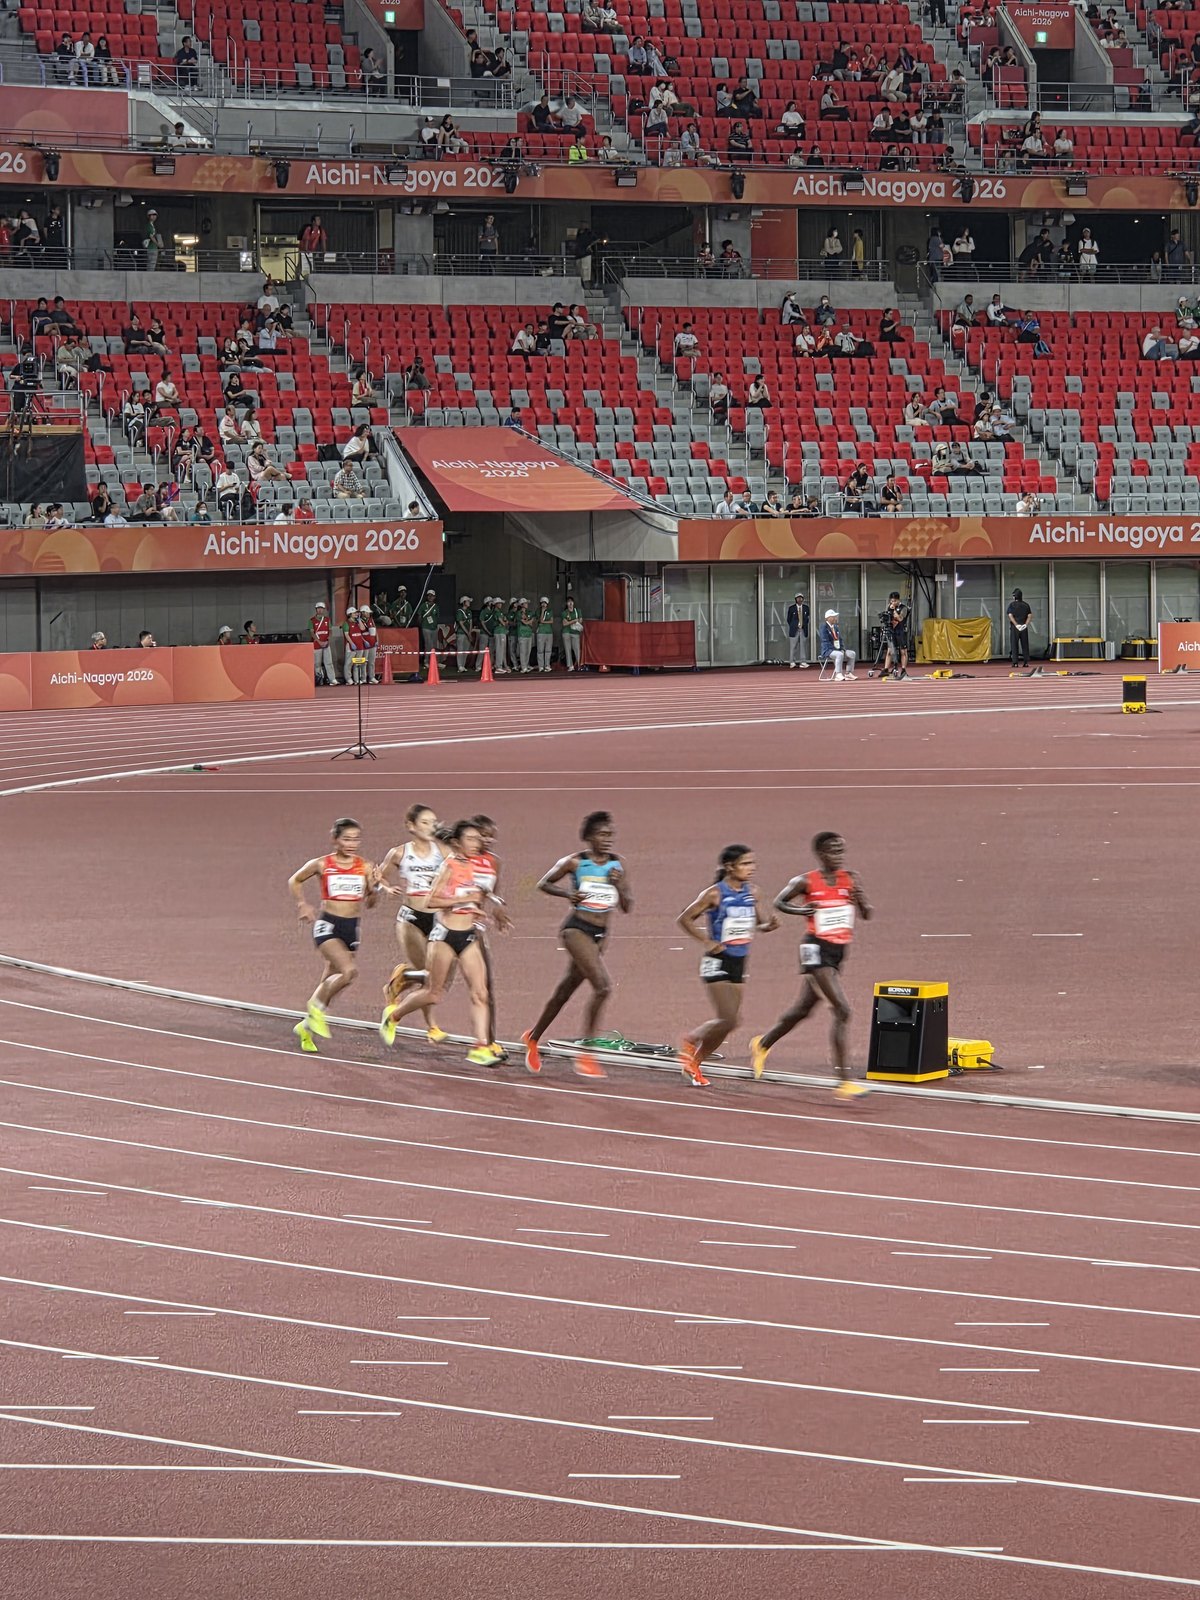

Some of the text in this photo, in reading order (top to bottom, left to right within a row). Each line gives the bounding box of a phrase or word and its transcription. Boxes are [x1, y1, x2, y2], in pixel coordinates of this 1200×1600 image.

[1014, 8, 1070, 19] Aichi-Nagoya
[1032, 18, 1052, 26] 2026
[0, 151, 27, 174] 26
[305, 163, 520, 192] Aichi-Ngoya 202
[792, 174, 946, 203] AichNagoya
[432, 459, 560, 471] Aichi-Nagoya
[480, 469, 530, 478] 2026
[1028, 520, 1184, 549] Aichi-Nagoya
[203, 528, 420, 561] Aichi-Nagoya 2026
[50, 670, 154, 686] Aichi-Nagoya 2026
